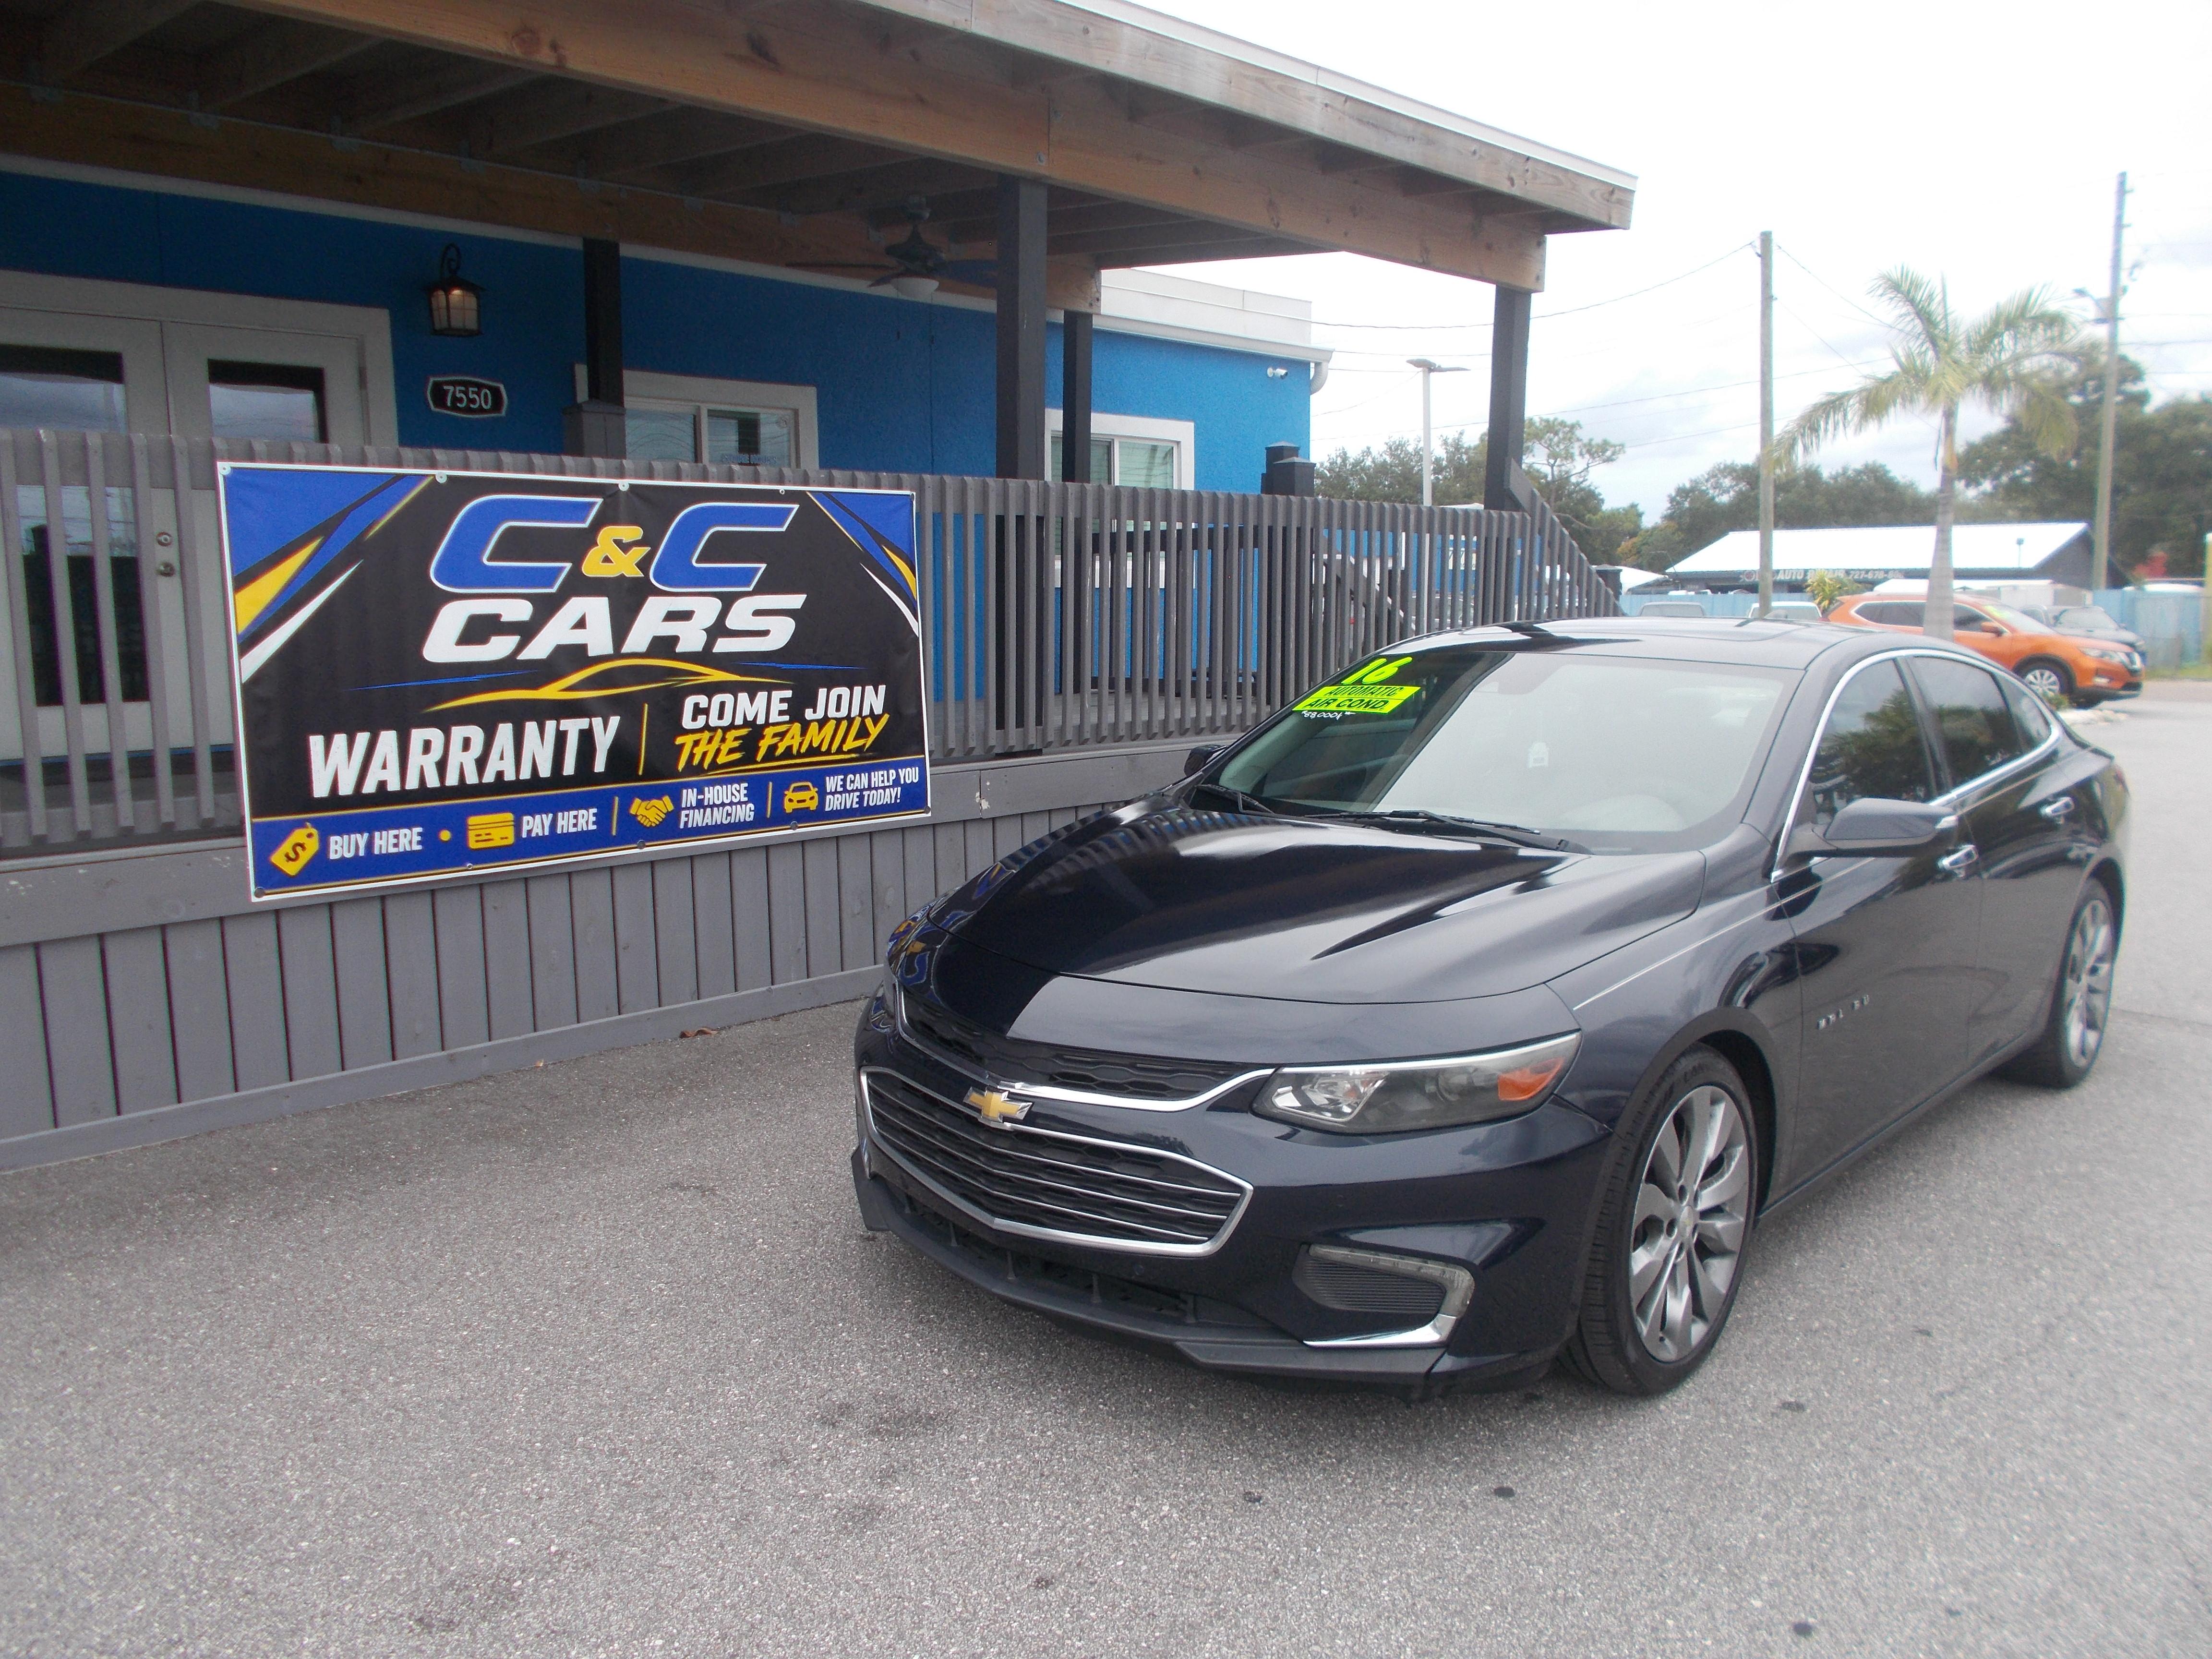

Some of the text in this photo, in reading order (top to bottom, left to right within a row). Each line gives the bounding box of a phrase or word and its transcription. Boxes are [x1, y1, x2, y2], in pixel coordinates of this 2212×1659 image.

[443, 385, 492, 409] 7550
[430, 494, 799, 593] C&C
[1777, 569, 1805, 580] AUTO
[422, 594, 807, 663] CARS
[1341, 657, 1412, 685] 16
[1303, 698, 1389, 710] AIR COND.
[1325, 686, 1404, 697] AUTOMATIC
[682, 685, 886, 729] COME JOIN
[675, 713, 890, 772] THE FAMILY
[309, 716, 620, 797] WARRANTY
[826, 767, 919, 793] WE CAN HELP YOU
[681, 783, 748, 807] IN-HOUSE
[825, 787, 901, 812] DRIVE TODAY!
[522, 808, 597, 838] PAY HERE
[680, 804, 754, 829] FINANCING
[328, 827, 422, 860] BUY HERE
